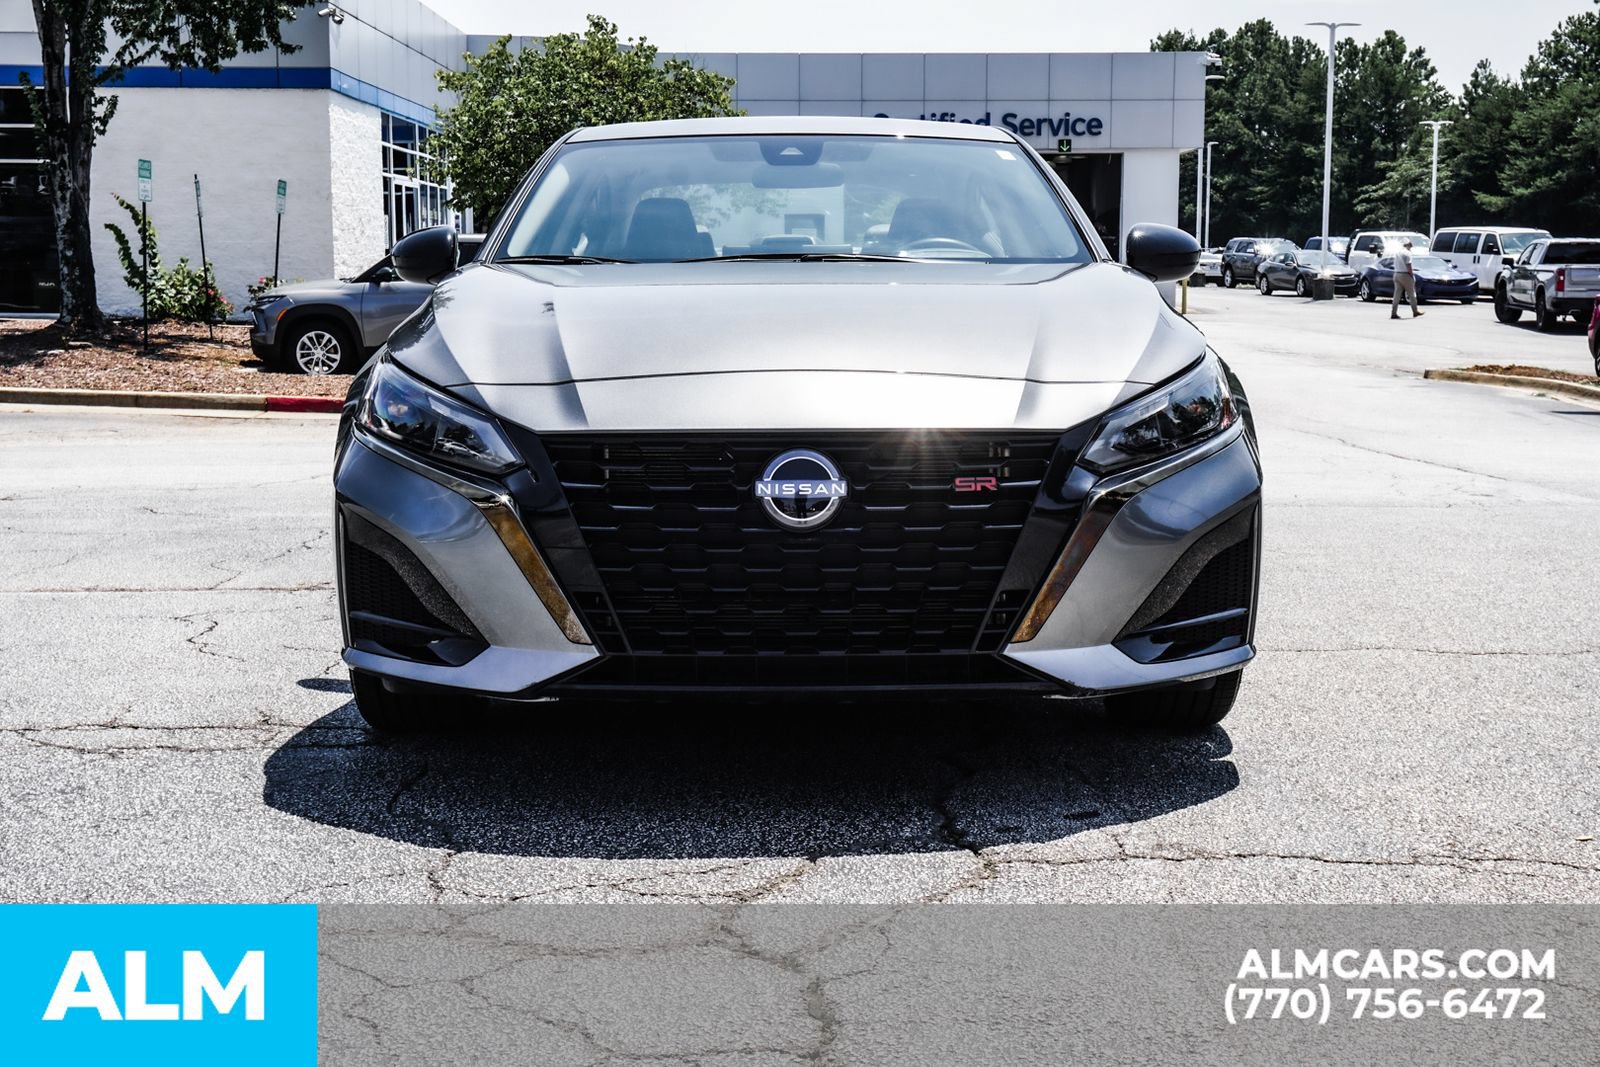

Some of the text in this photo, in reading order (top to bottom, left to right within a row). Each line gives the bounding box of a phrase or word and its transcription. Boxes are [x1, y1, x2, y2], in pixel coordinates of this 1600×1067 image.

[1001, 112, 1103, 137] Service
[757, 483, 846, 495] NISSAN
[954, 476, 998, 492] SR
